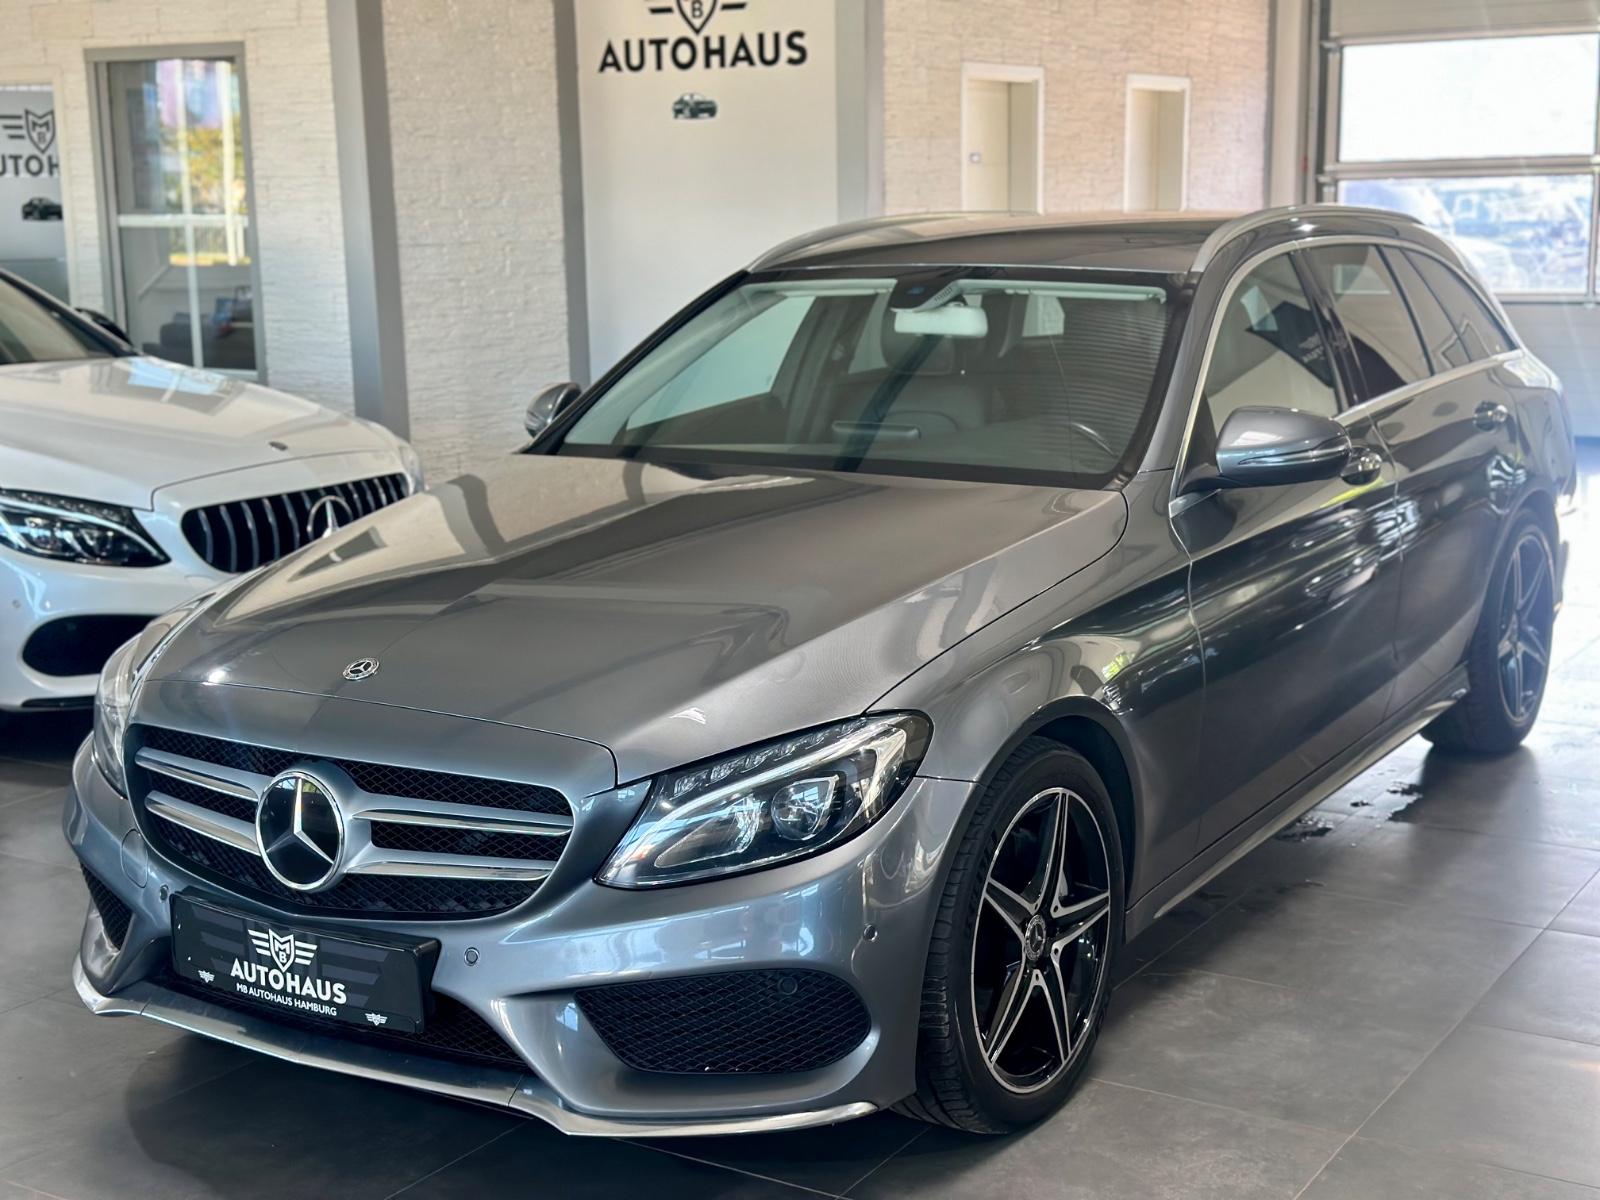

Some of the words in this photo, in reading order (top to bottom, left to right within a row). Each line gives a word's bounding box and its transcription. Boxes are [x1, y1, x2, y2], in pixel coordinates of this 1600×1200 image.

[598, 30, 808, 73] AUTOHAUS
[279, 951, 288, 964] B
[230, 957, 347, 1005] AUTOHAUS
[248, 987, 293, 1006] AUTOHAUS
[294, 999, 337, 1016] HAMBURG
